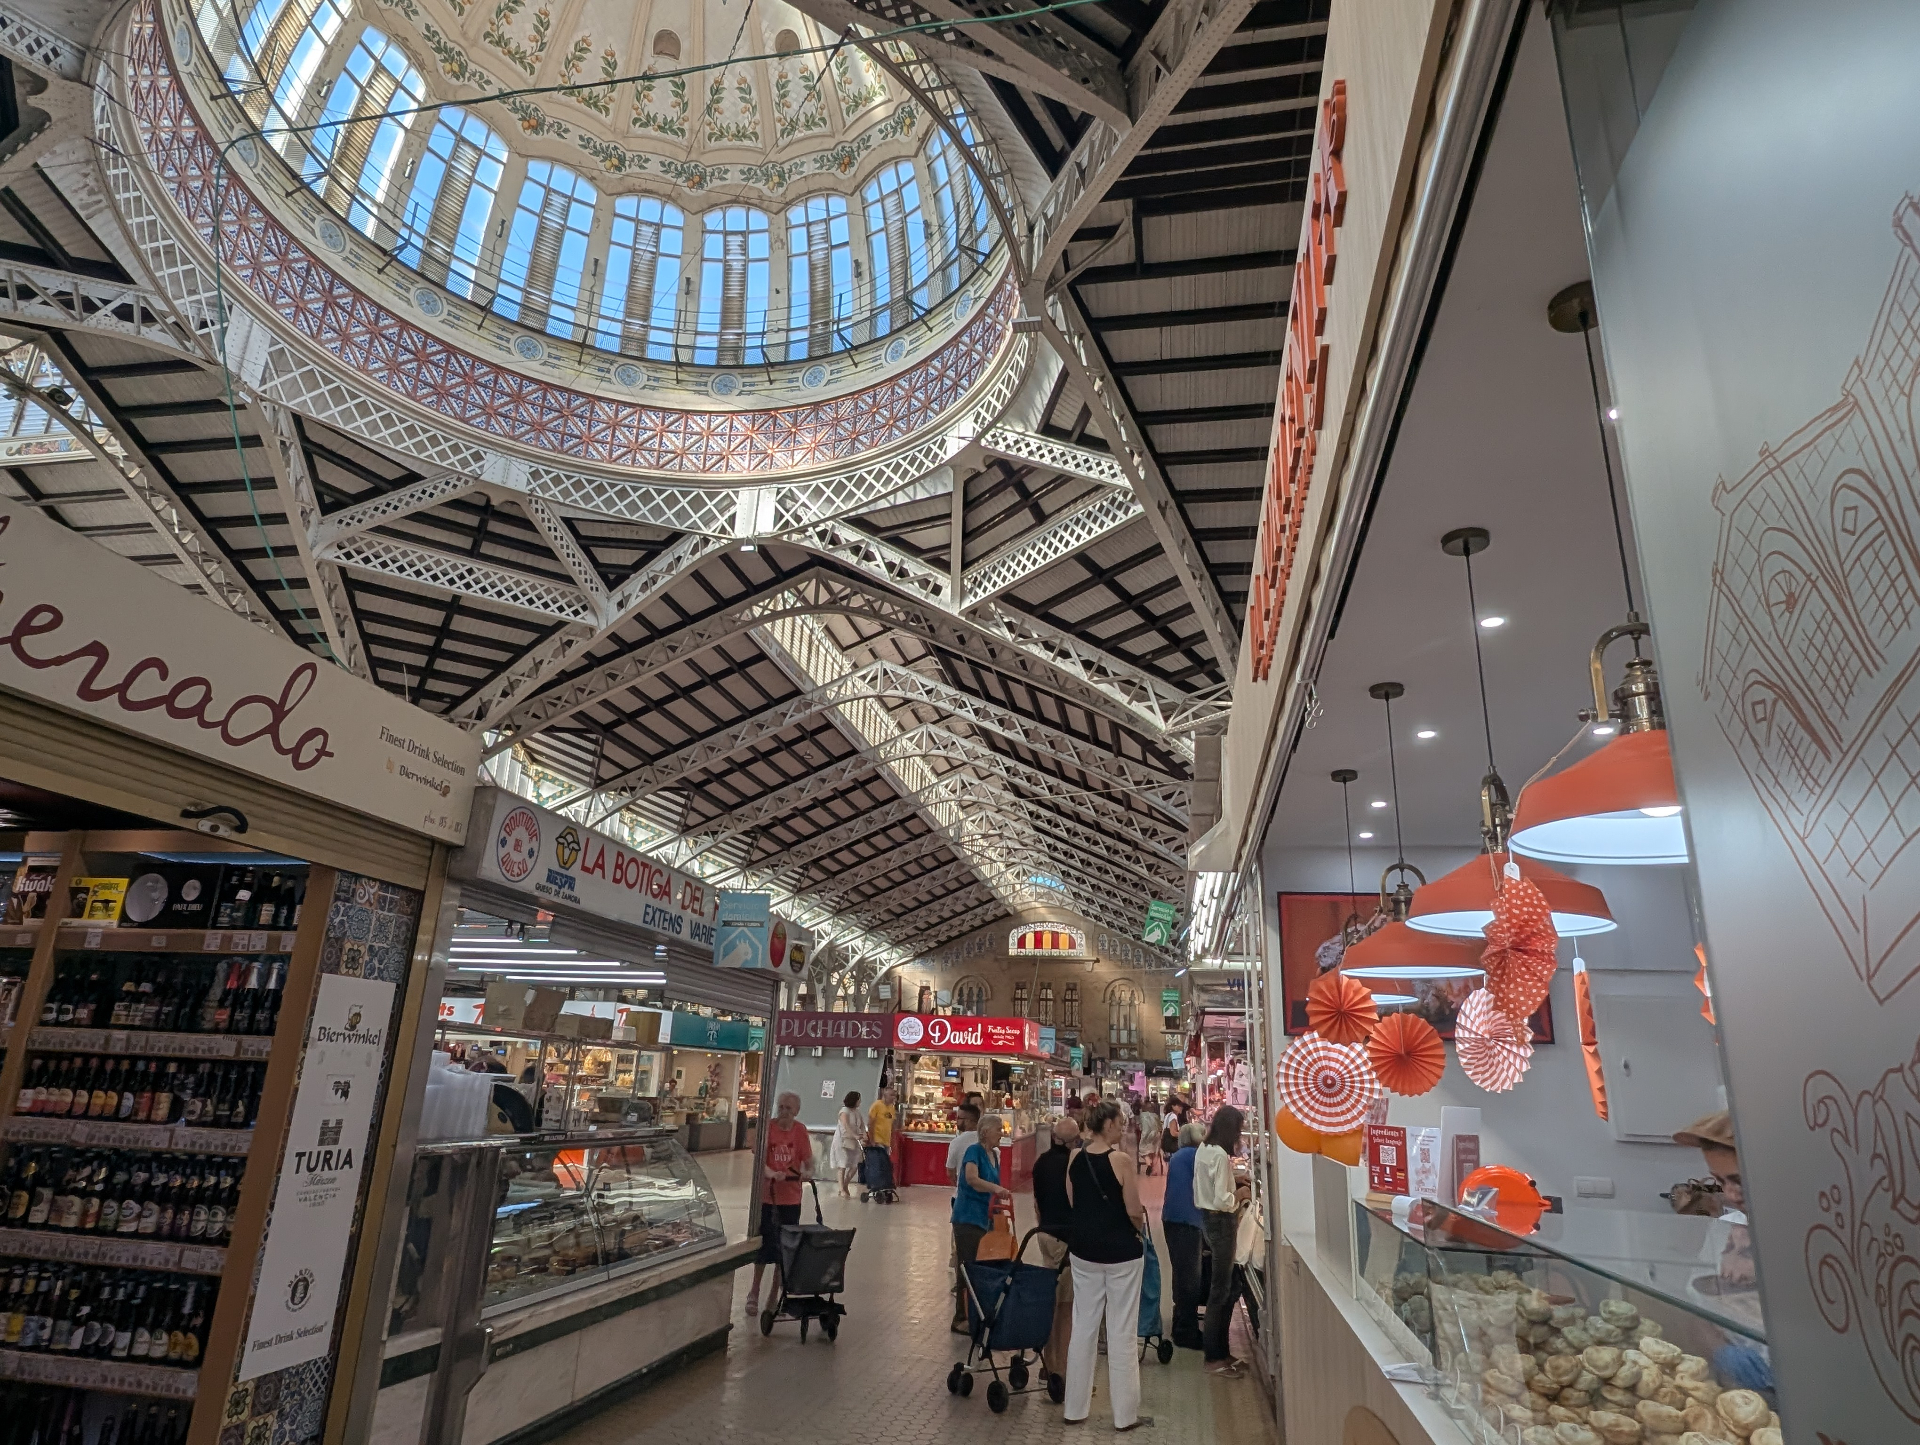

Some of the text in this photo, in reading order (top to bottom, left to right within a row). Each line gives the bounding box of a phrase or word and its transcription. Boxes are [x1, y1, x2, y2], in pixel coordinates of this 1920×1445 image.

[0, 590, 334, 771] ercado
[379, 726, 466, 776] Finest Drink Selection
[399, 764, 444, 792] Bierwinkel
[504, 811, 538, 844] BOUTIQUE
[513, 837, 523, 854] DEL
[501, 852, 528, 878] QUESO
[580, 837, 606, 880] LA
[612, 851, 672, 905] BOTIGA
[681, 880, 704, 917] DEL
[536, 882, 580, 905] QUESO DE ZAMORA
[643, 904, 683, 935] EXTENS
[317, 1026, 382, 1046] Bierwinkel
[779, 1018, 883, 1039] PUCHADES
[928, 1018, 984, 1046] David
[295, 1148, 353, 1175] TURIA
[299, 1193, 336, 1202] VALENCIA
[252, 1337, 273, 1352] Finest
[275, 1330, 294, 1345] Drink
